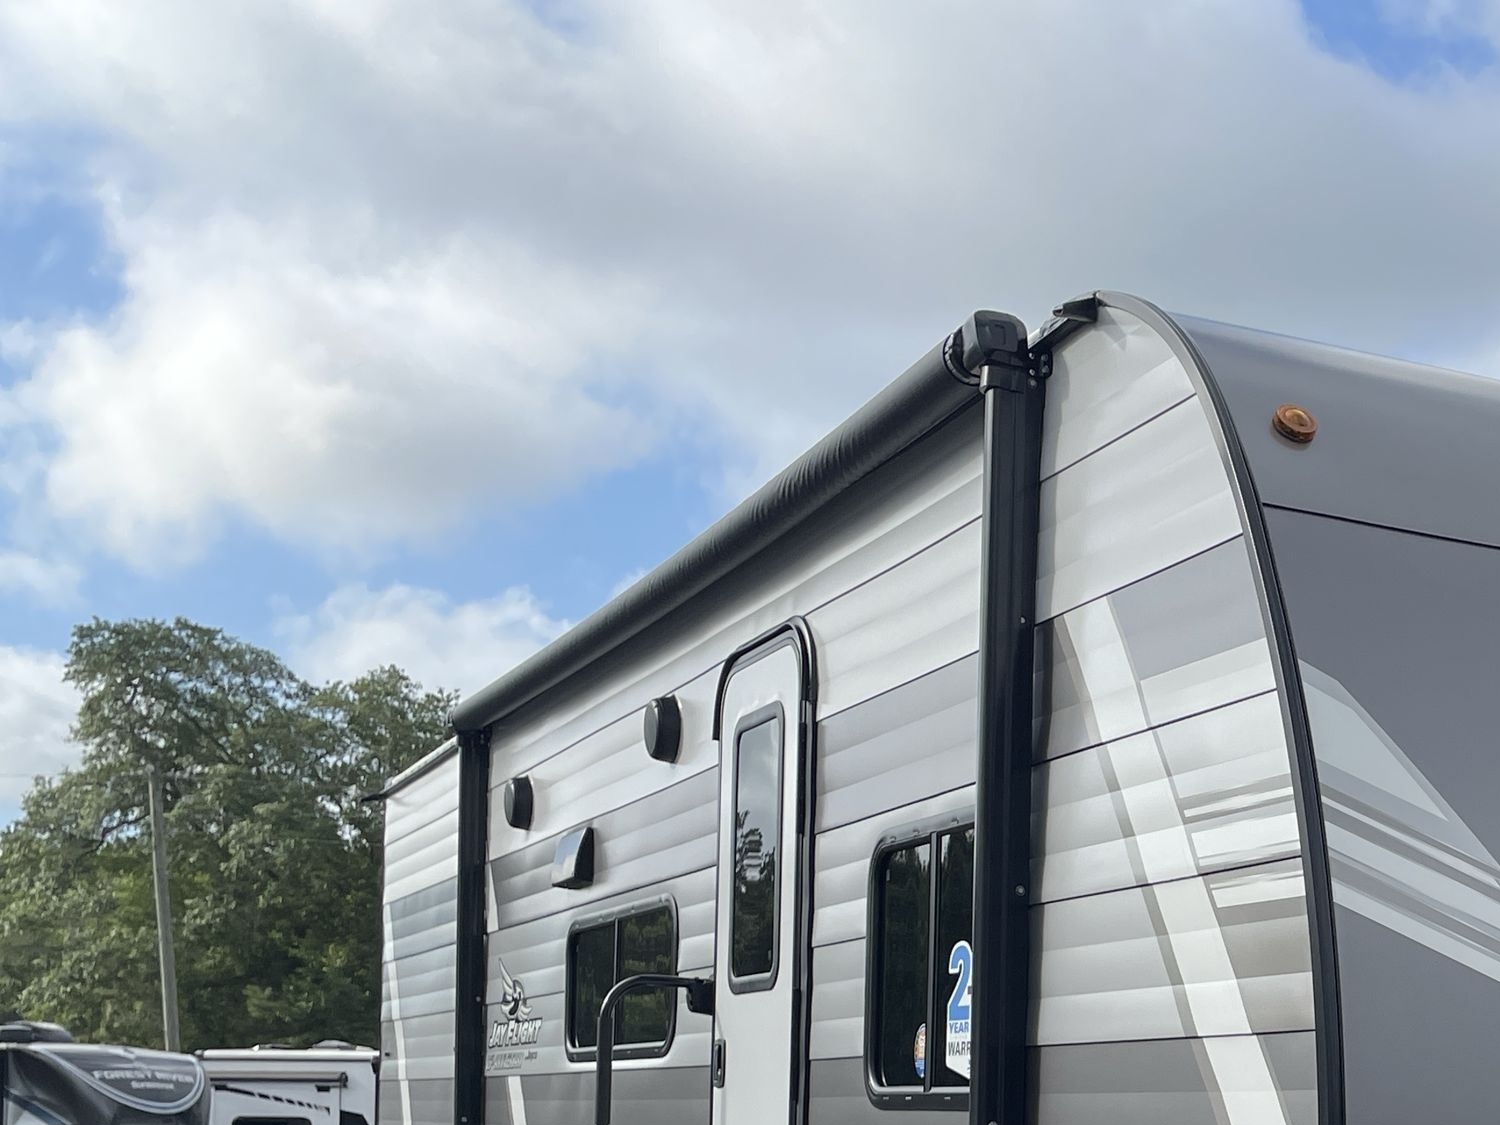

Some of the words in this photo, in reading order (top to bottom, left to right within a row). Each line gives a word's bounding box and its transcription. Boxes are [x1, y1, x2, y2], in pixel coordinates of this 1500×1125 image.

[488, 1020, 509, 1049] JAY
[505, 1016, 543, 1046] FLIGHT
[948, 1022, 969, 1034] YEAR
